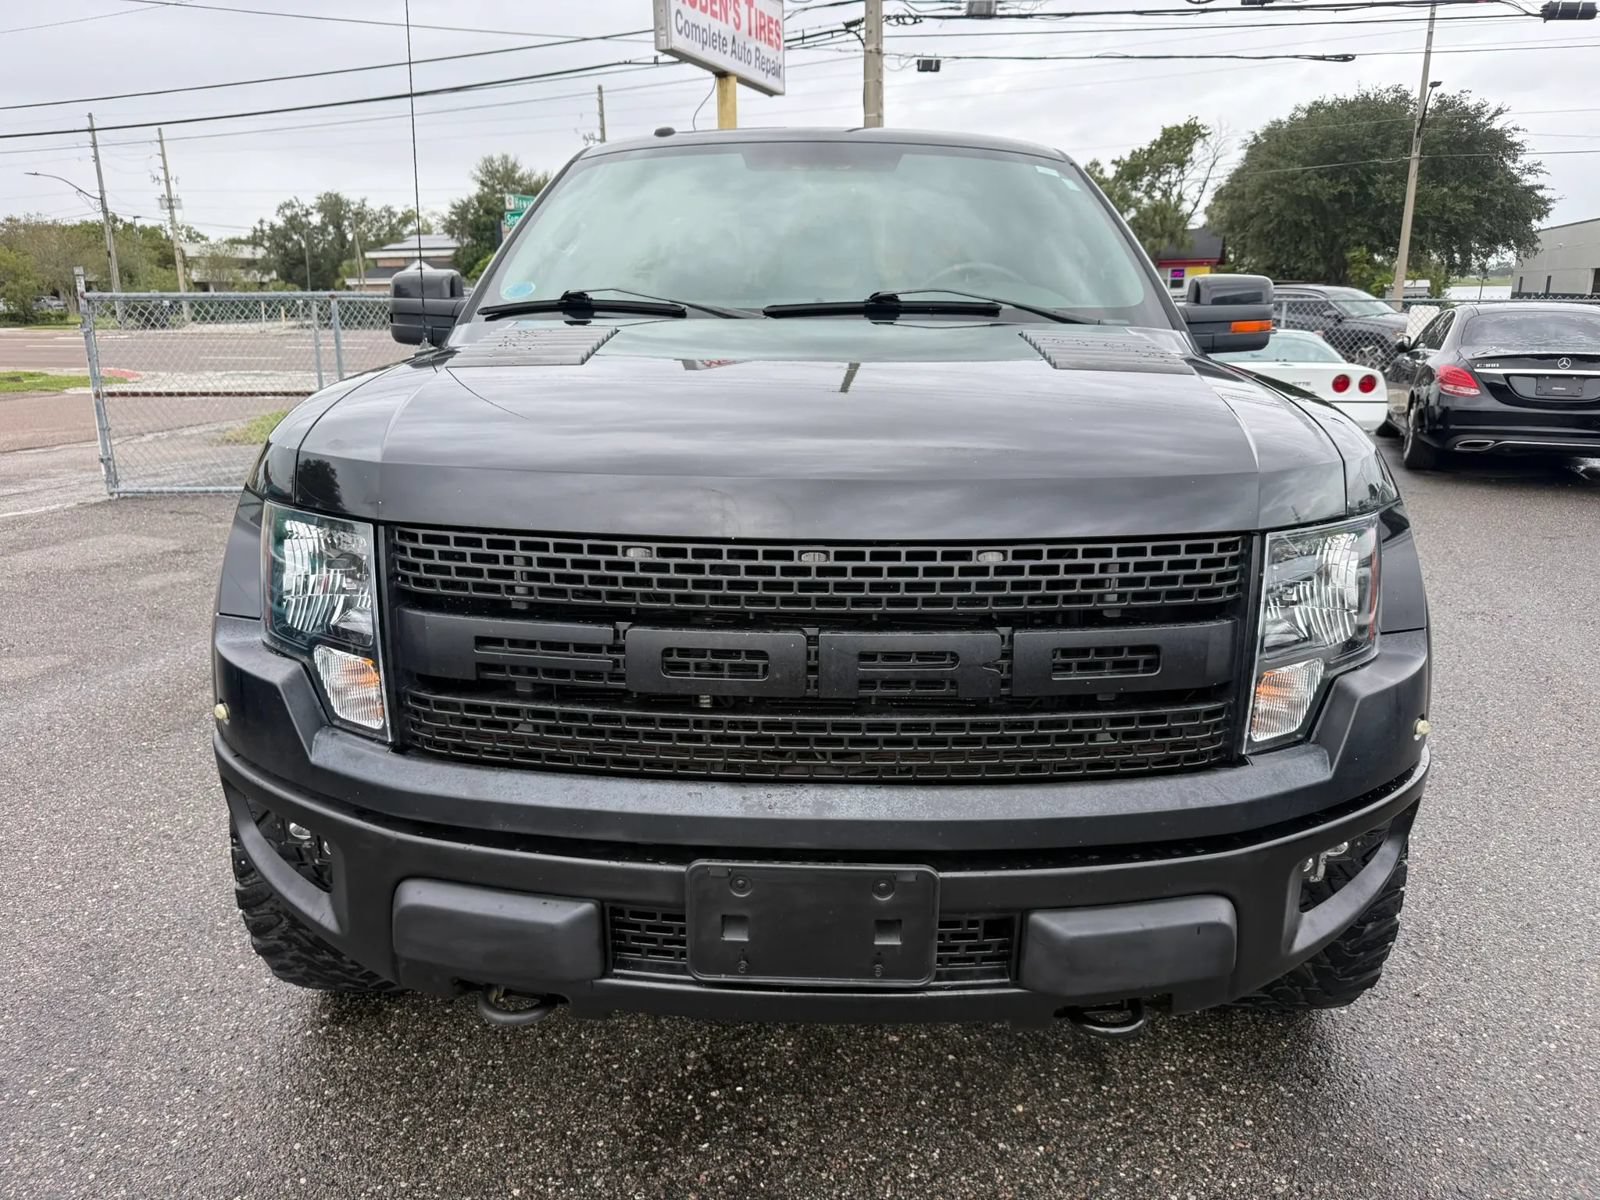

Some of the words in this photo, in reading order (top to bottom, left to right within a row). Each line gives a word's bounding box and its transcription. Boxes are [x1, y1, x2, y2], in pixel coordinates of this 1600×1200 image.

[675, 9, 728, 54] Complete
[730, 35, 752, 66] Auto
[754, 47, 782, 78] Repair
[679, 0, 742, 31] EN'S
[745, 0, 781, 51] TIRES
[400, 608, 1235, 698] FORD
